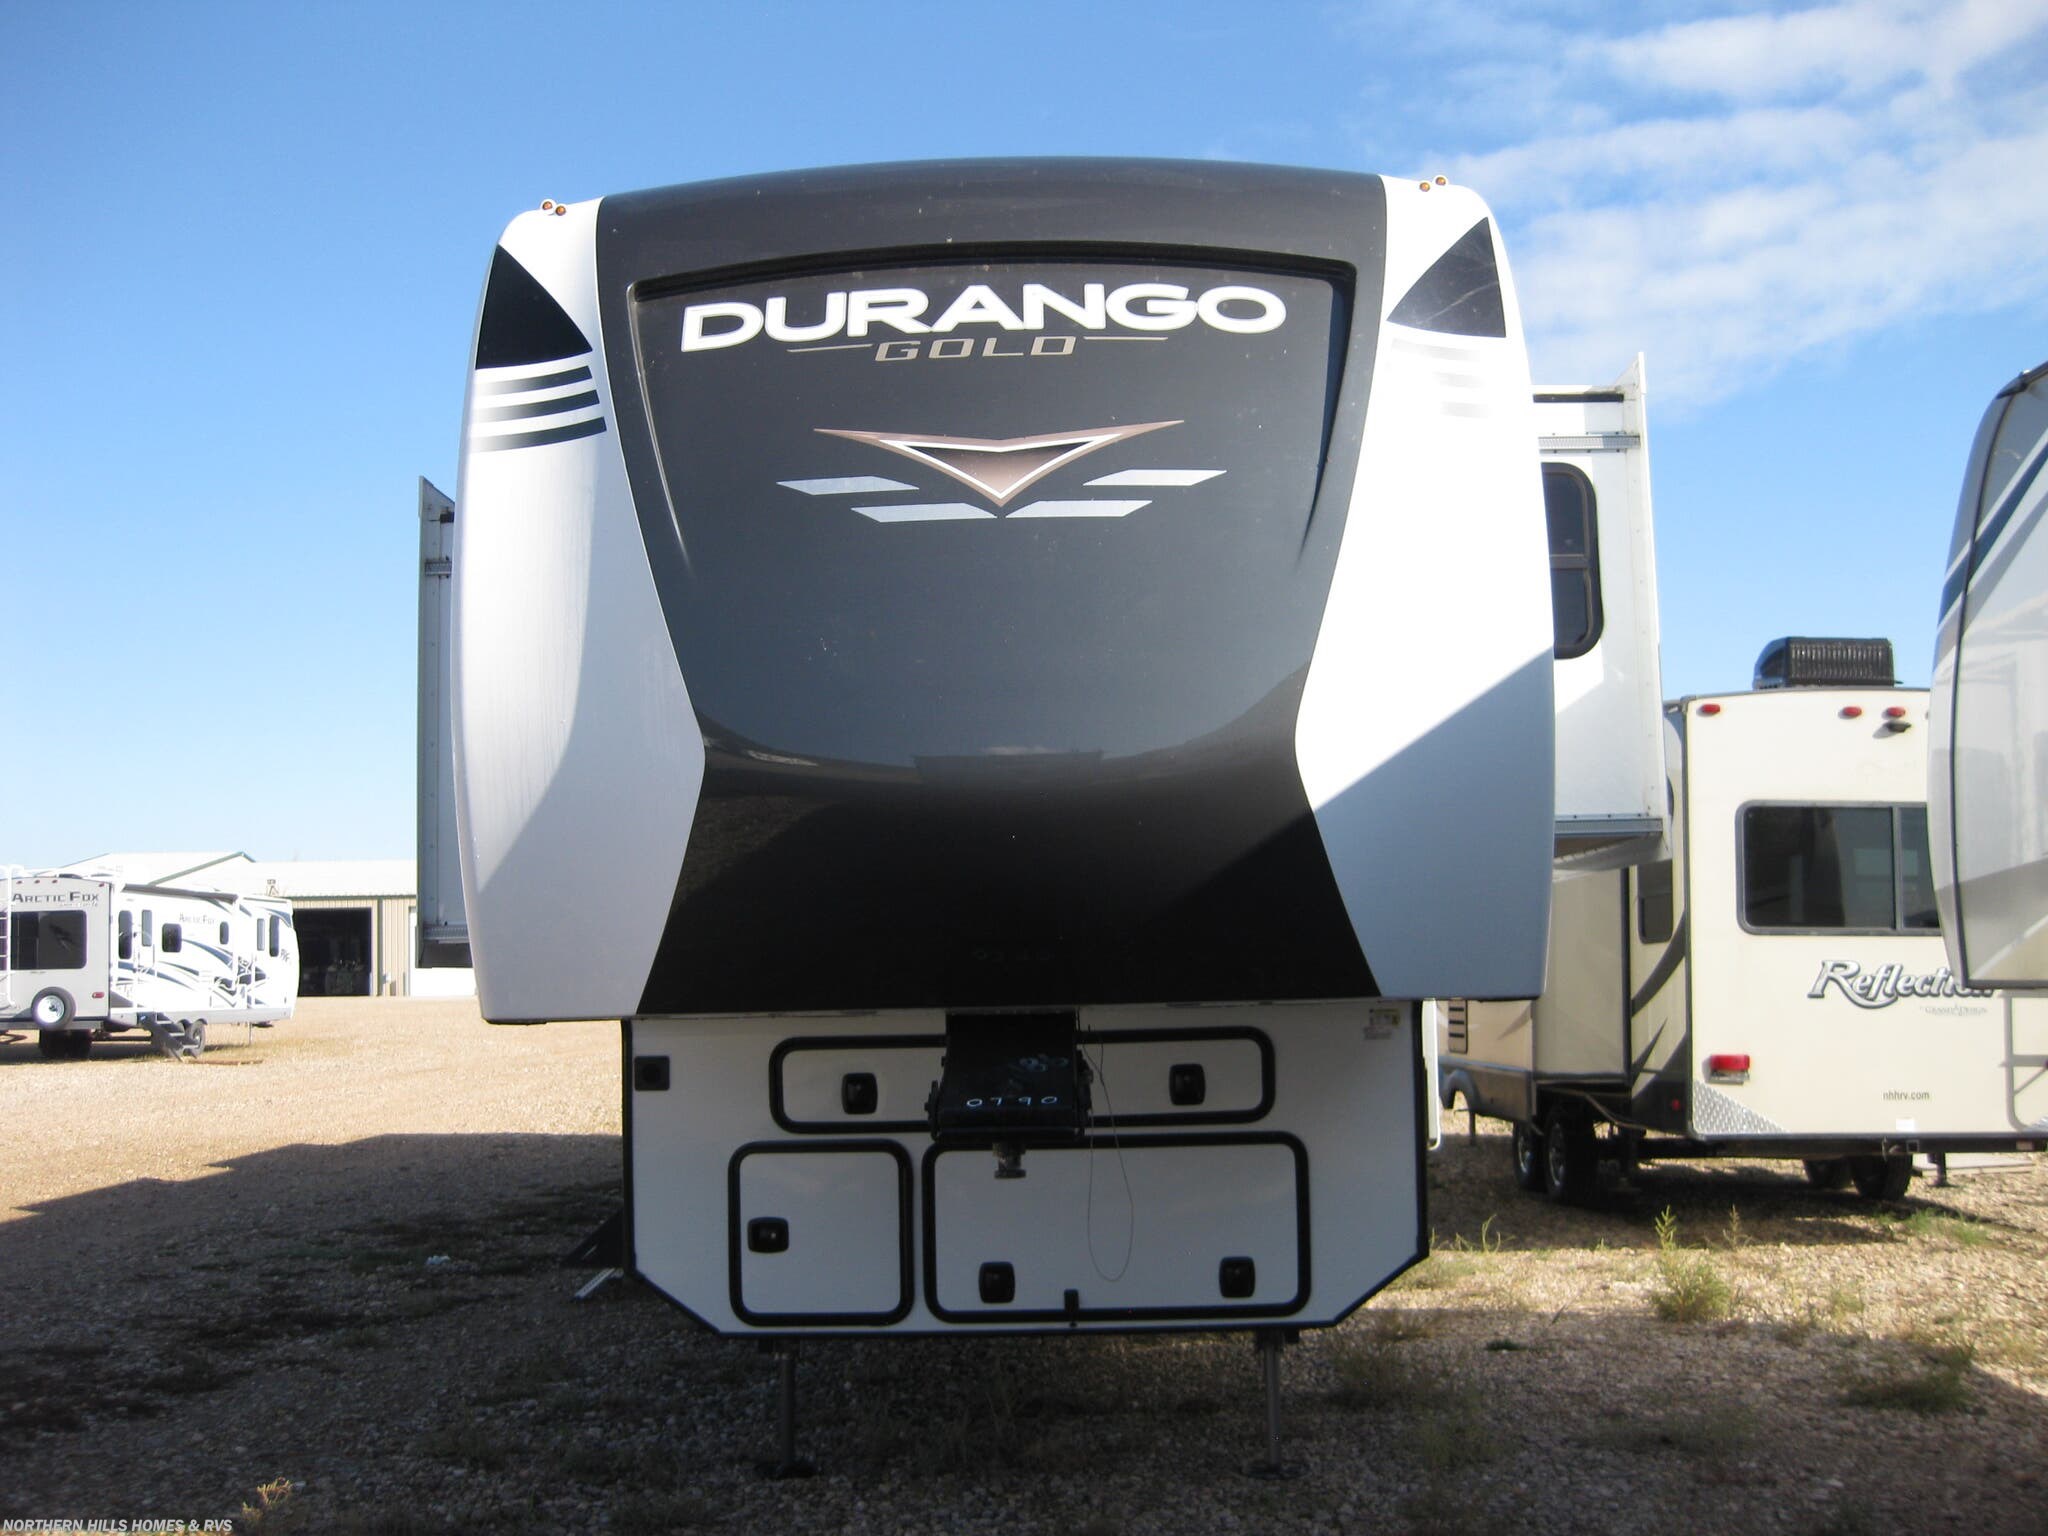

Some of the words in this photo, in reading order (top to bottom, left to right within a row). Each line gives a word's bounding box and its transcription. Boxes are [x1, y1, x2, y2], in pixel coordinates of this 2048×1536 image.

[681, 282, 1287, 353] DURANGO
[875, 336, 1078, 361] GOLD
[1807, 960, 1993, 1010] Reflecti
[1882, 1090, 1930, 1101] nhhrv.com
